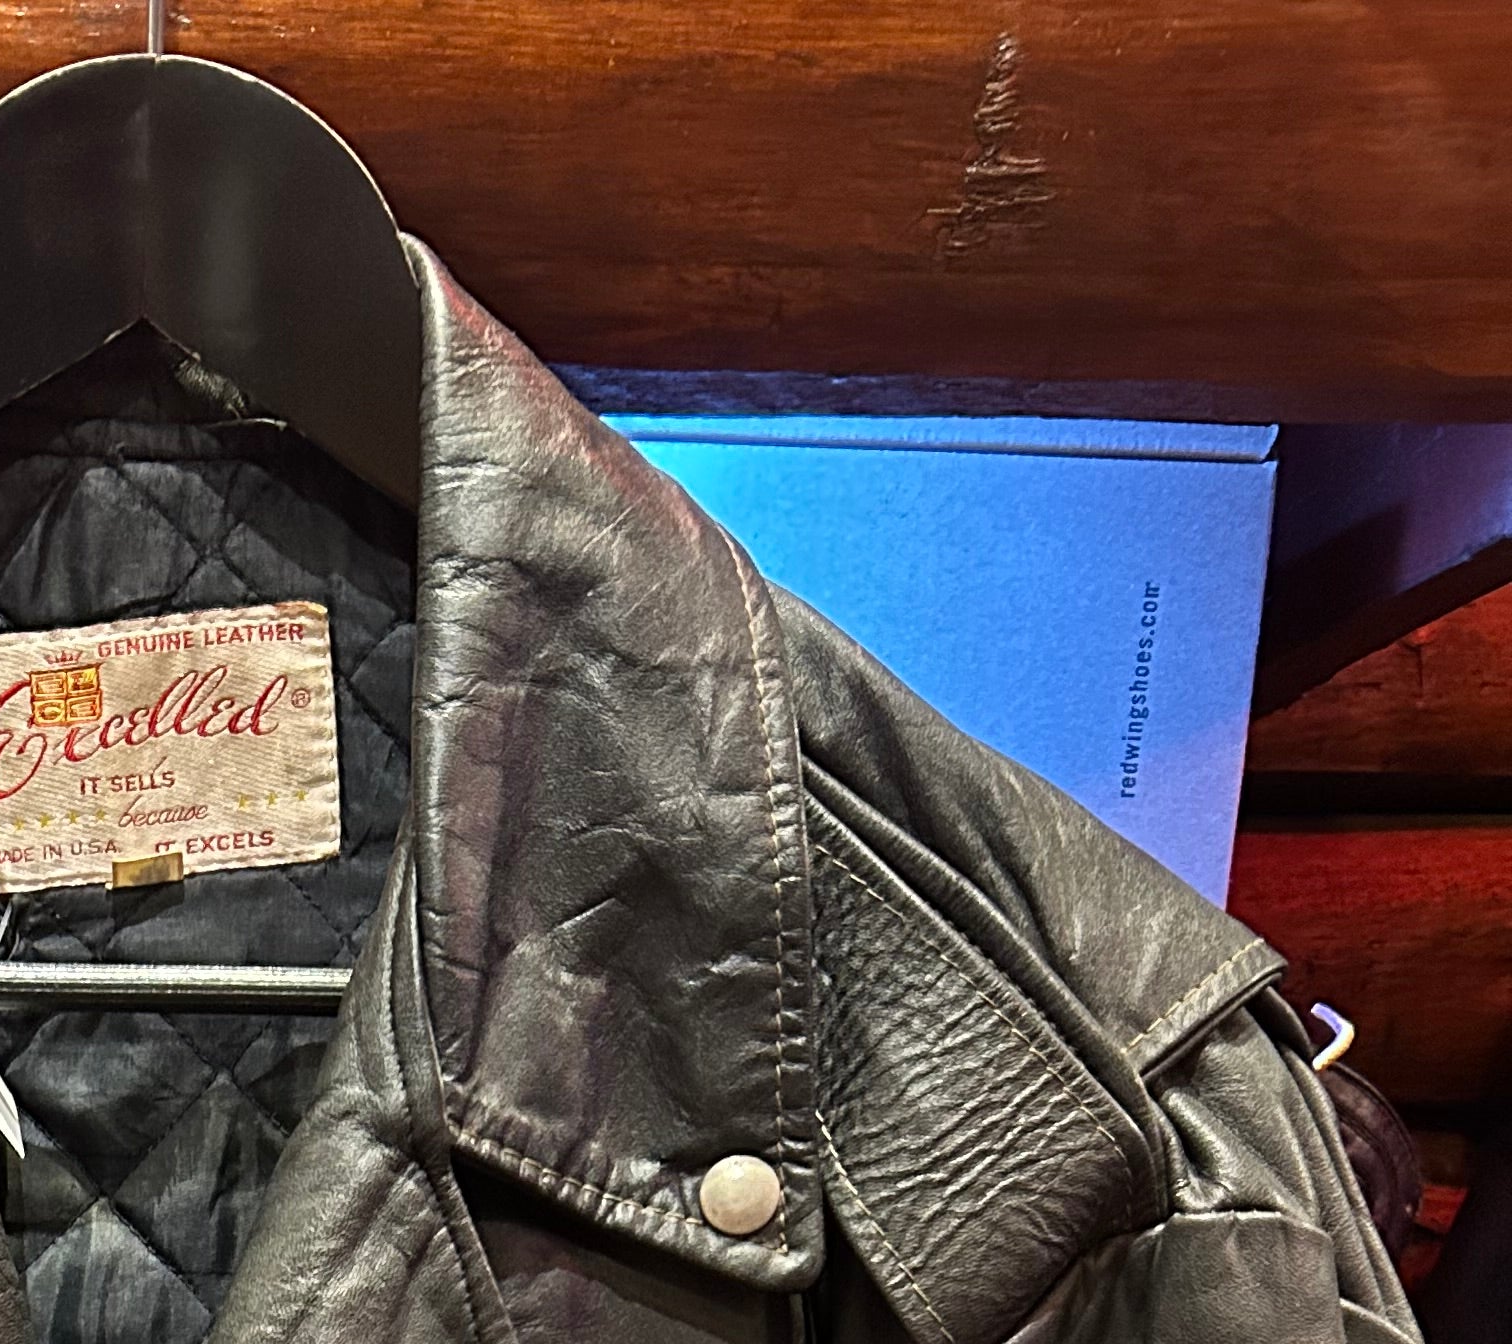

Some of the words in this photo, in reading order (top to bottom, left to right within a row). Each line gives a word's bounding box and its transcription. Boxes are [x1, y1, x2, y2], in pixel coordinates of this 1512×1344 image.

[97, 631, 195, 658] GENUINE
[202, 622, 305, 648] LEATHER
[1119, 579, 1160, 799] redwingshoes.com
[79, 777, 102, 795] IT
[109, 768, 176, 794] SELLS
[117, 794, 210, 828] because
[41, 844, 63, 860] IN
[70, 840, 123, 856] U.S.A.
[186, 829, 275, 855] EXCELS
